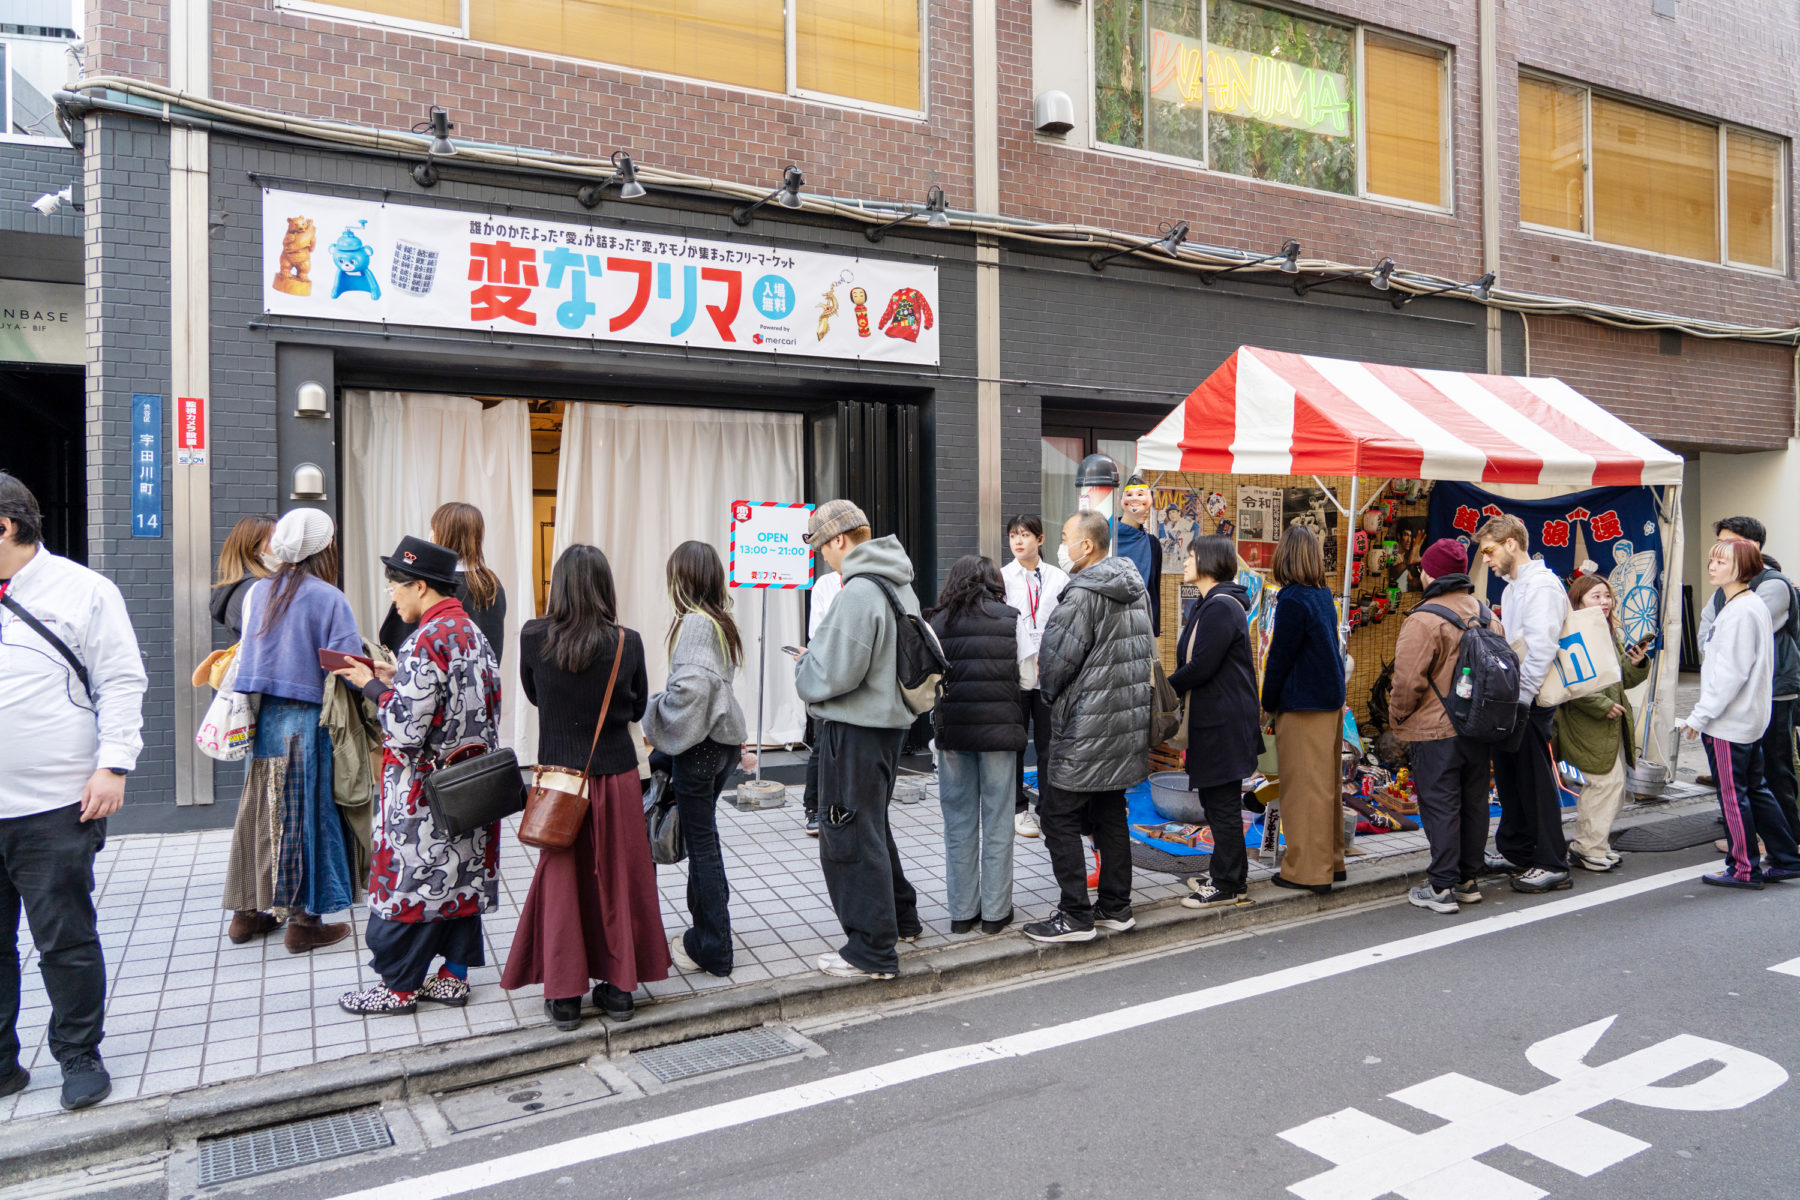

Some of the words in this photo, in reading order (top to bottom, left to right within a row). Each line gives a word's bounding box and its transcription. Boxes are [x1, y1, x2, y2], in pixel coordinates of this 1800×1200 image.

[1149, 29, 1351, 131] WANIMA
[469, 220, 796, 270] 誰かのかたよった「愛」が詰まった「変」なモノが集まったフリーマーケット
[467, 240, 743, 342] 変なフリマ
[762, 281, 786, 298] 入場
[762, 296, 786, 313] 無料
[759, 323, 783, 333] Powered
[783, 325, 791, 333] by
[765, 336, 797, 346] mercari
[140, 433, 155, 496] 宇田川町
[1241, 495, 1272, 509] 令和
[736, 505, 749, 520] 変
[136, 513, 159, 529] 14
[757, 531, 789, 543] OPEN
[739, 545, 768, 555] 13:00
[777, 546, 806, 556] 21:00
